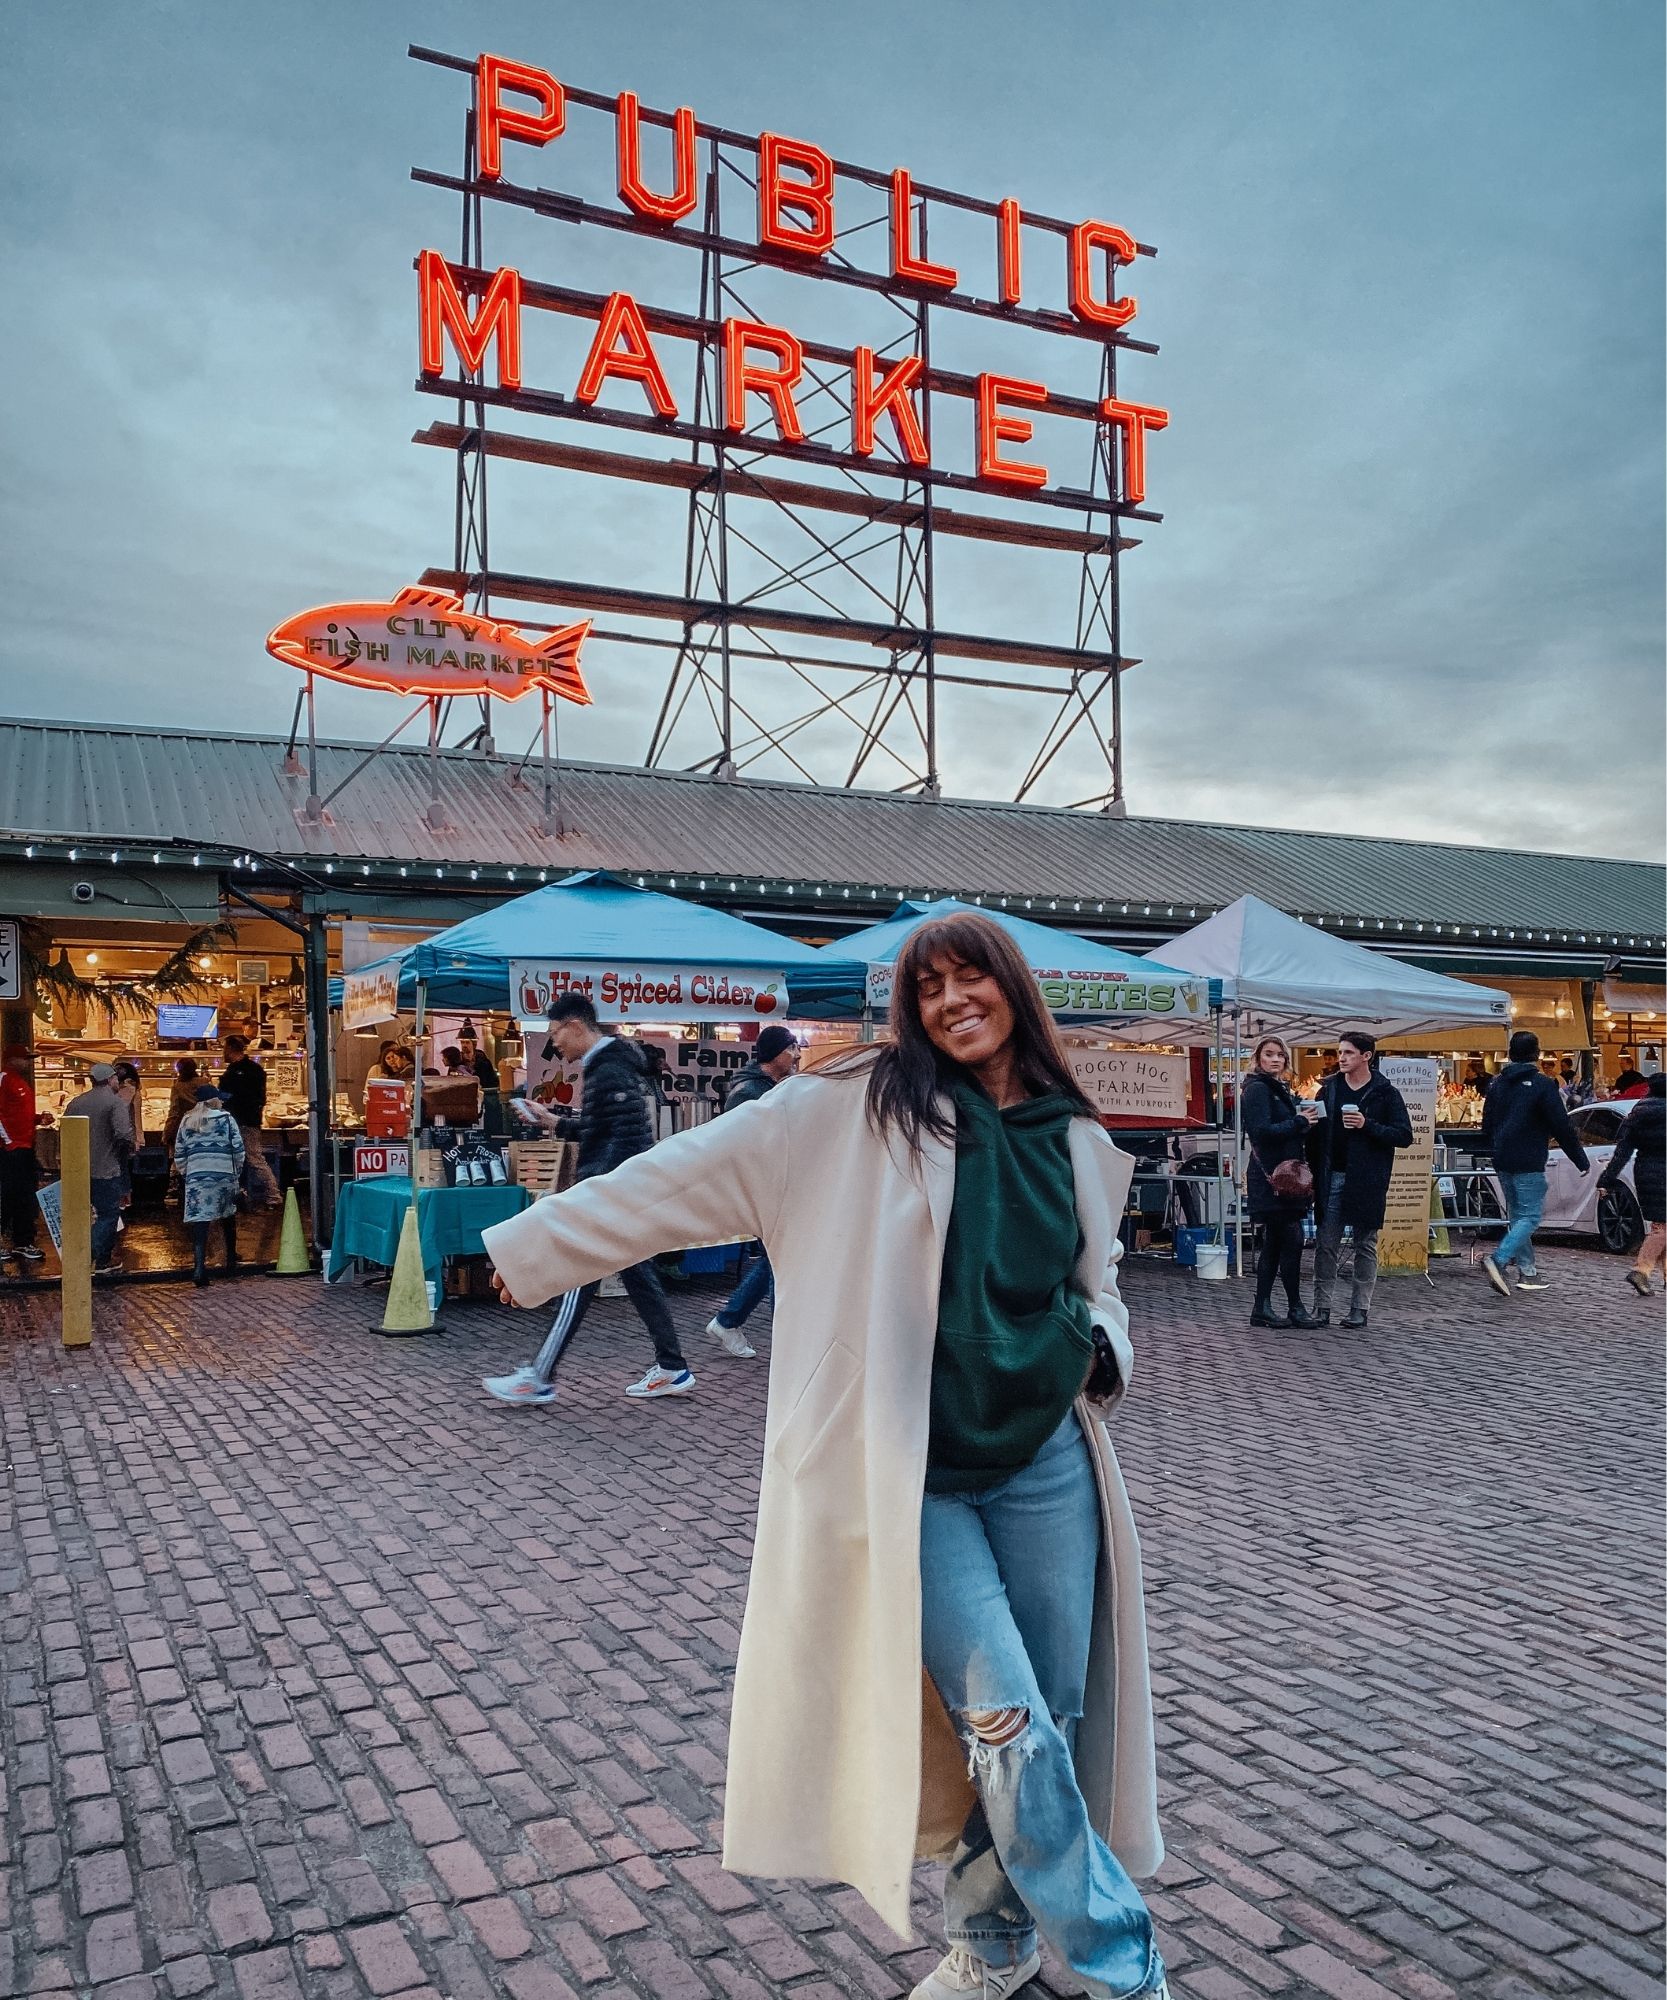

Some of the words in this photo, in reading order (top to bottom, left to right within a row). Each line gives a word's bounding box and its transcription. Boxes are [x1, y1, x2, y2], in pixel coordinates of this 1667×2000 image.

[475, 53, 1138, 330] PUBLIC
[418, 248, 1169, 506] MARKET
[386, 615, 481, 642] CITY
[304, 635, 389, 662] FISH
[407, 644, 556, 676] MARKET
[549, 971, 593, 1002] Hot
[600, 972, 684, 1013] Spiced
[691, 975, 755, 1006] Cider
[1074, 1060, 1127, 1077] FOGGY
[1136, 1062, 1169, 1083] HOG
[1385, 1066, 1411, 1078] FOGGY
[1415, 1066, 1432, 1078] HOG
[1097, 1080, 1145, 1095] FARM
[1396, 1078, 1420, 1086] FARM
[1411, 1114, 1428, 1122] MEAT
[360, 1152, 383, 1170] NO
[442, 1145, 462, 1162] HOT
